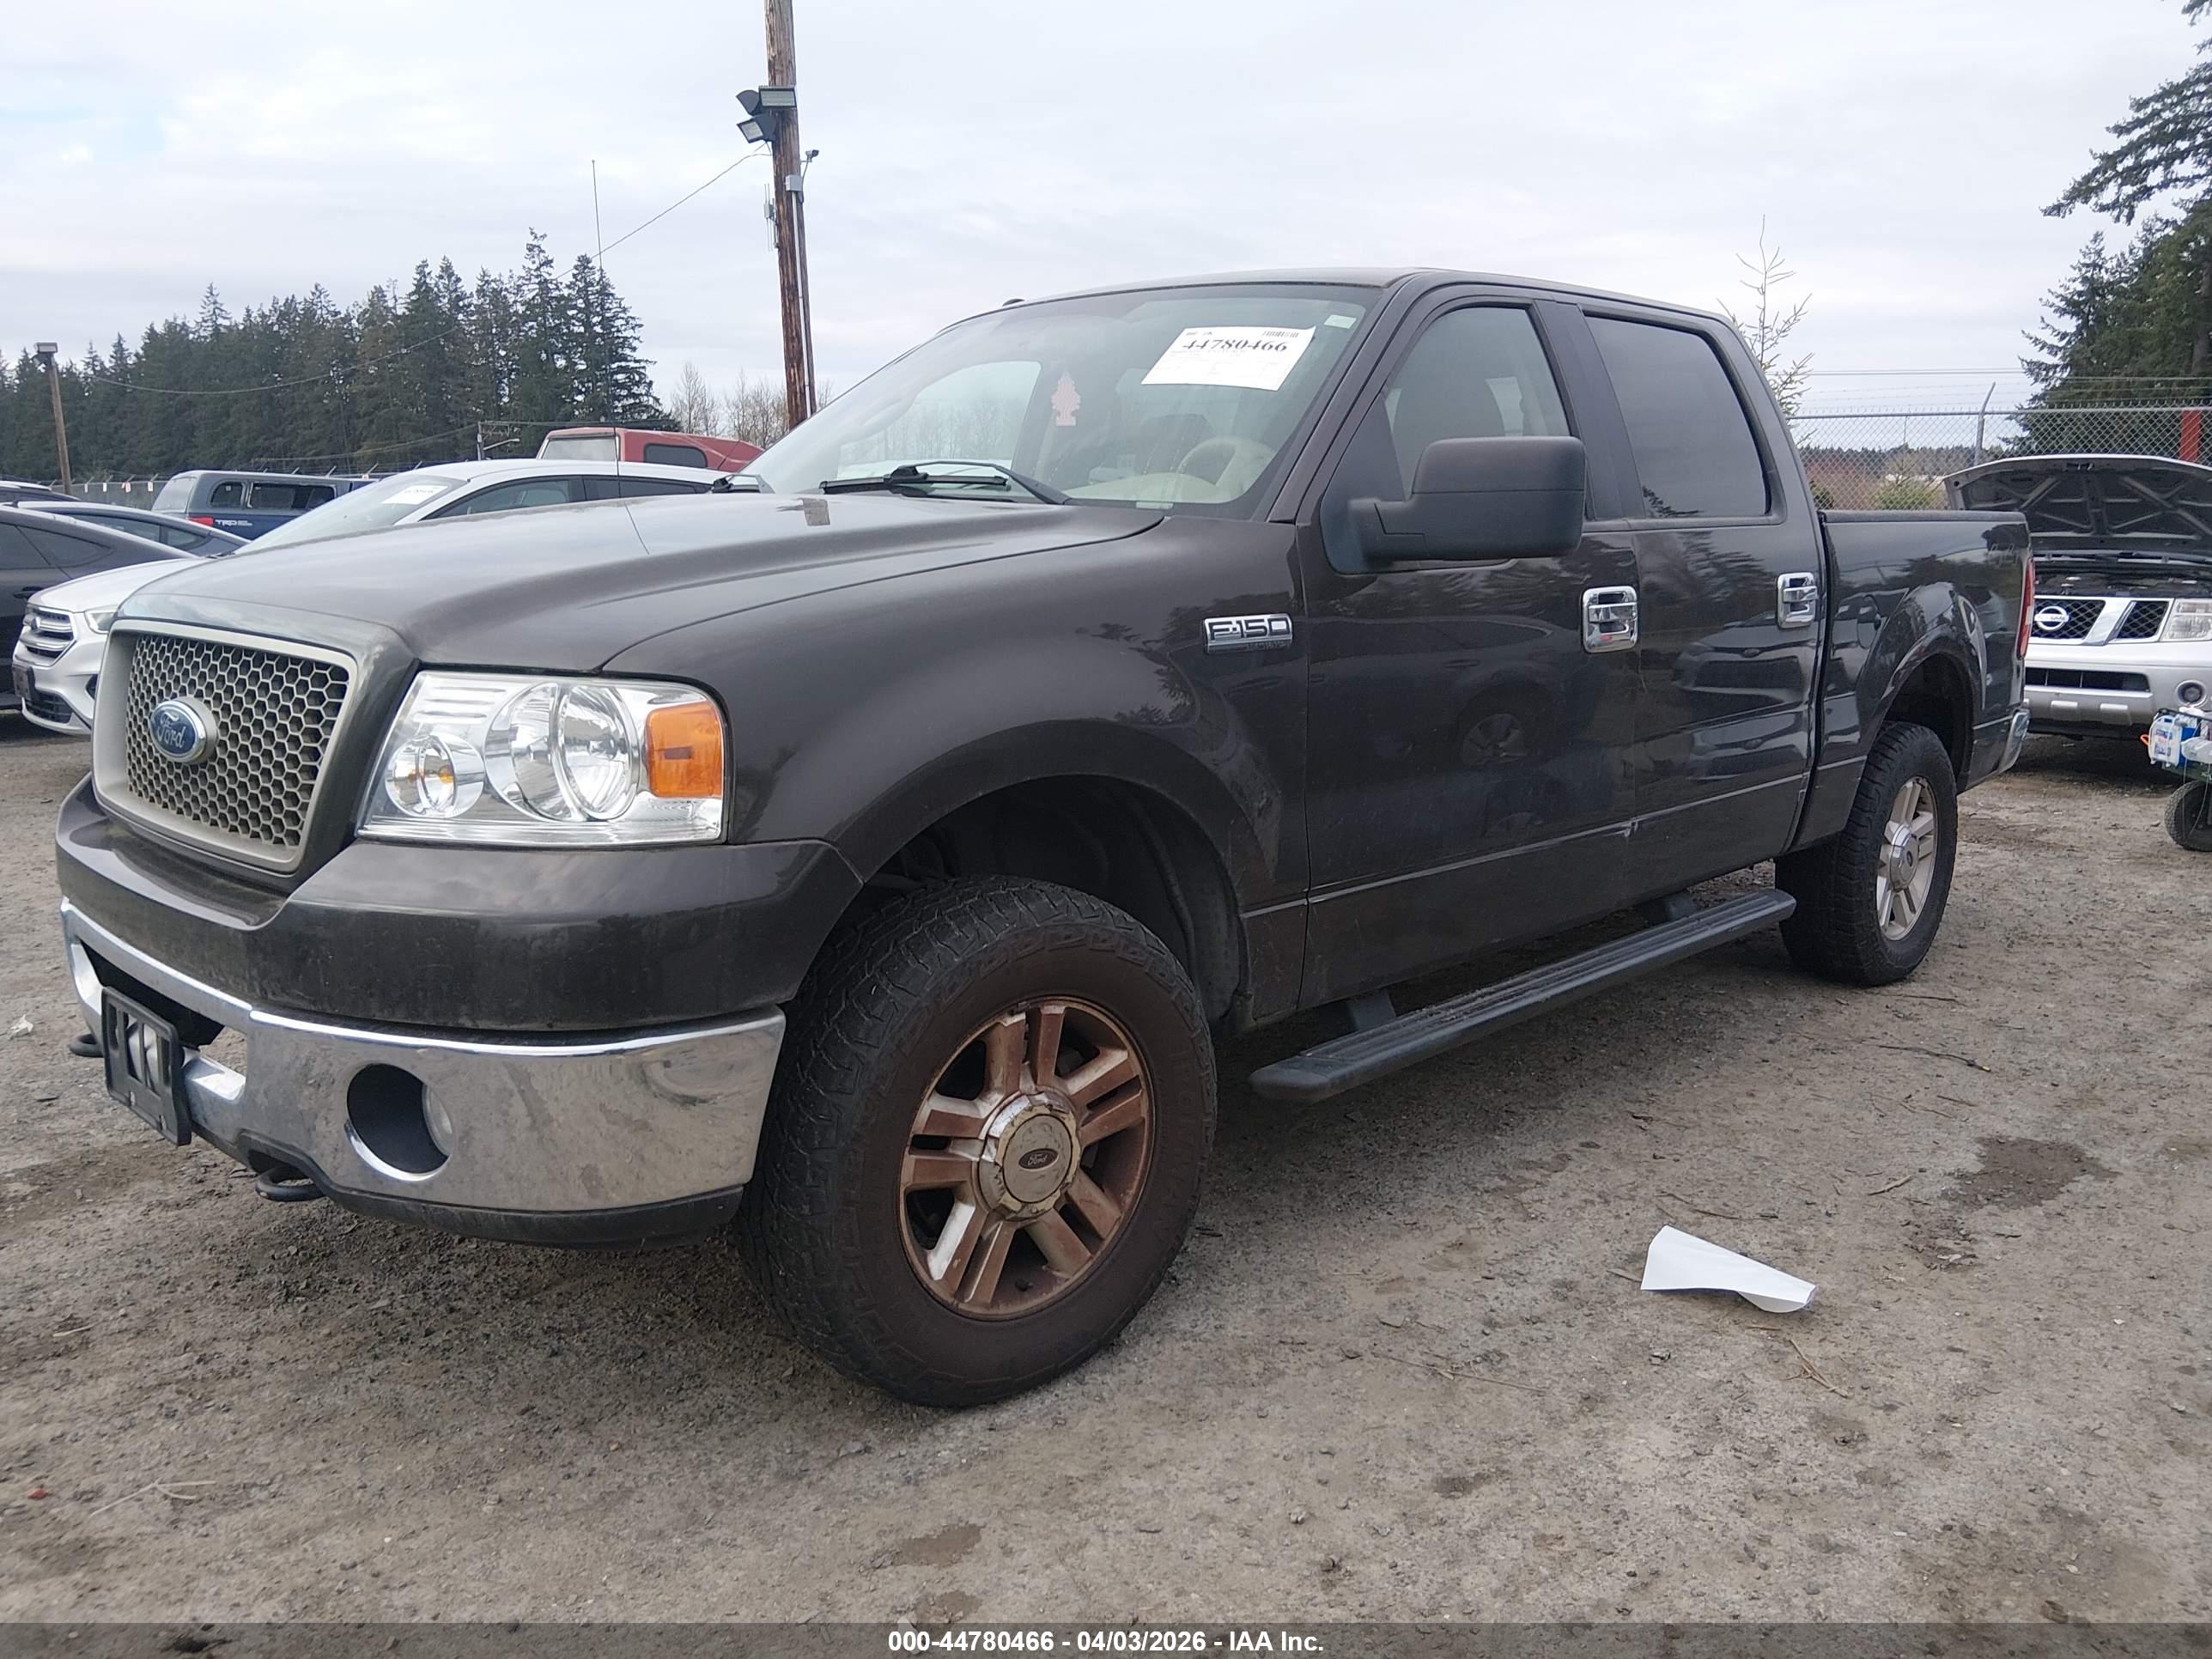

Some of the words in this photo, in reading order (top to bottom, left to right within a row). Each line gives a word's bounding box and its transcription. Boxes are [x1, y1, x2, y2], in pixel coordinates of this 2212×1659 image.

[1182, 338, 1290, 354] 44780466
[1208, 617, 1291, 641] F-150
[155, 711, 186, 749] Ford
[1027, 1153, 1048, 1167] Ford
